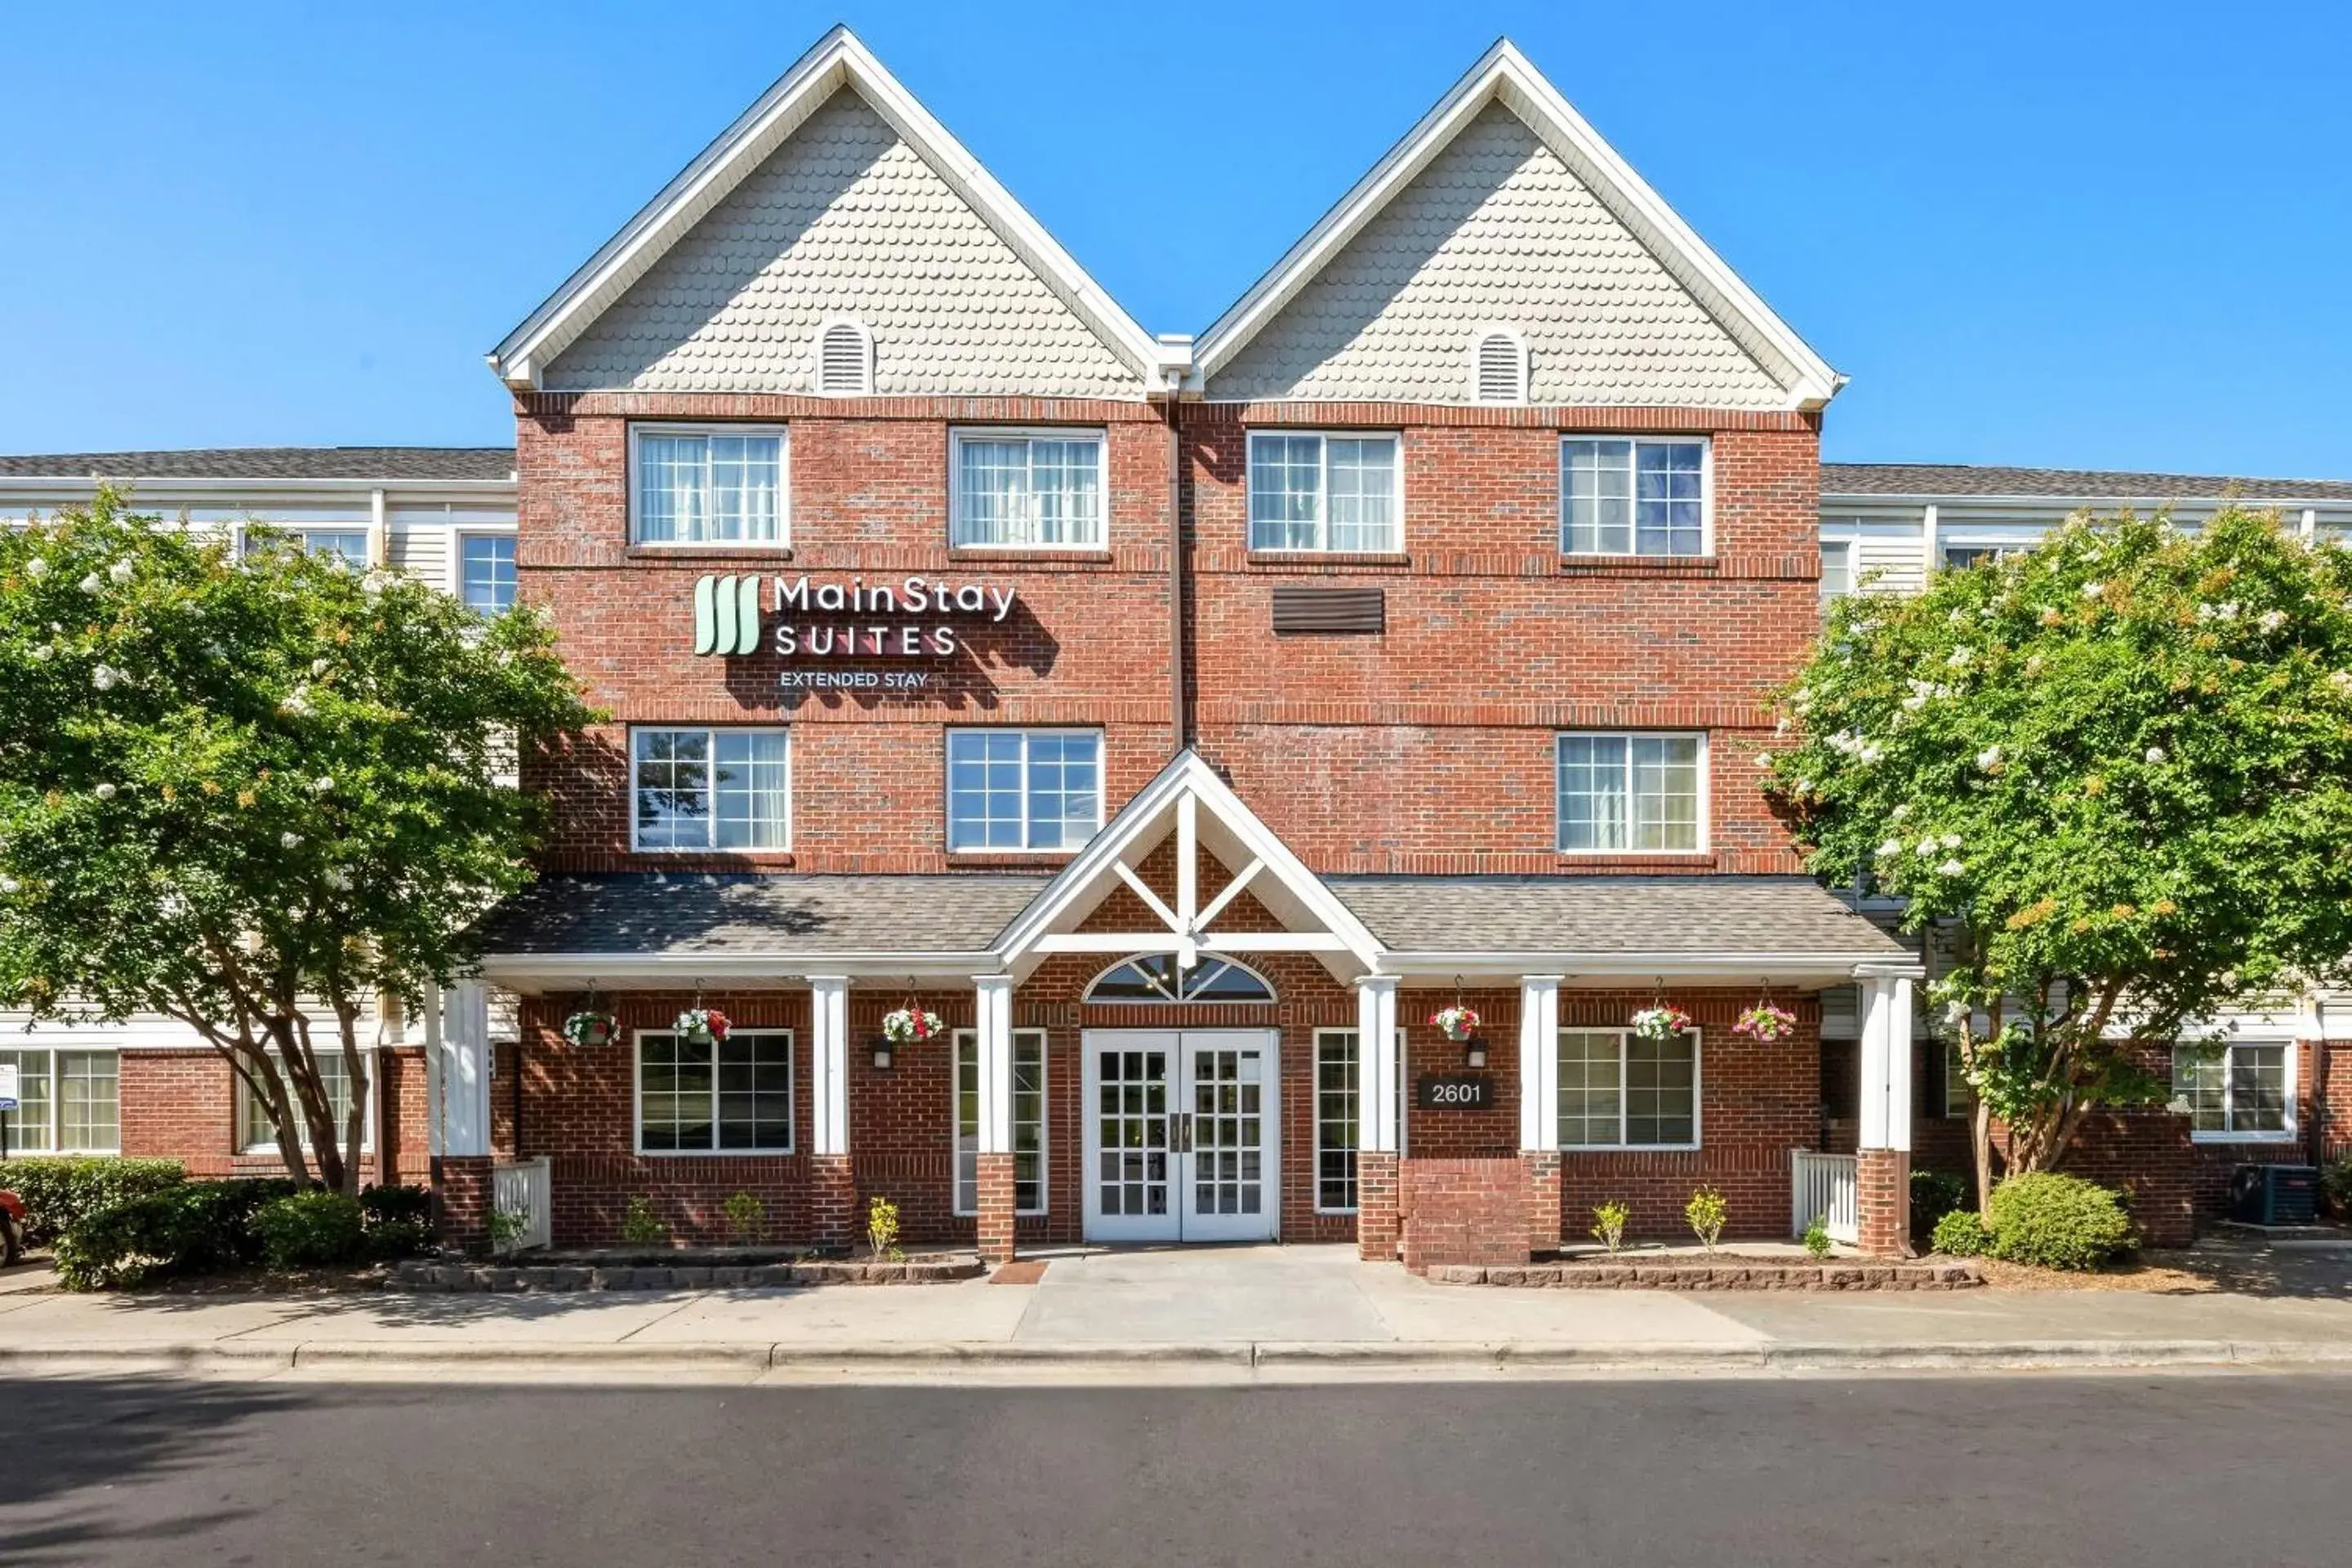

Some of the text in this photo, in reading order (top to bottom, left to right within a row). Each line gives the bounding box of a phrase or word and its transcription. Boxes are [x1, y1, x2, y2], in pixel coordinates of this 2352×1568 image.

[773, 576, 1015, 622] MainStay
[775, 626, 956, 655] SUITES
[780, 672, 928, 688] EXTENDED STAY
[1432, 1084, 1480, 1102] 2601
